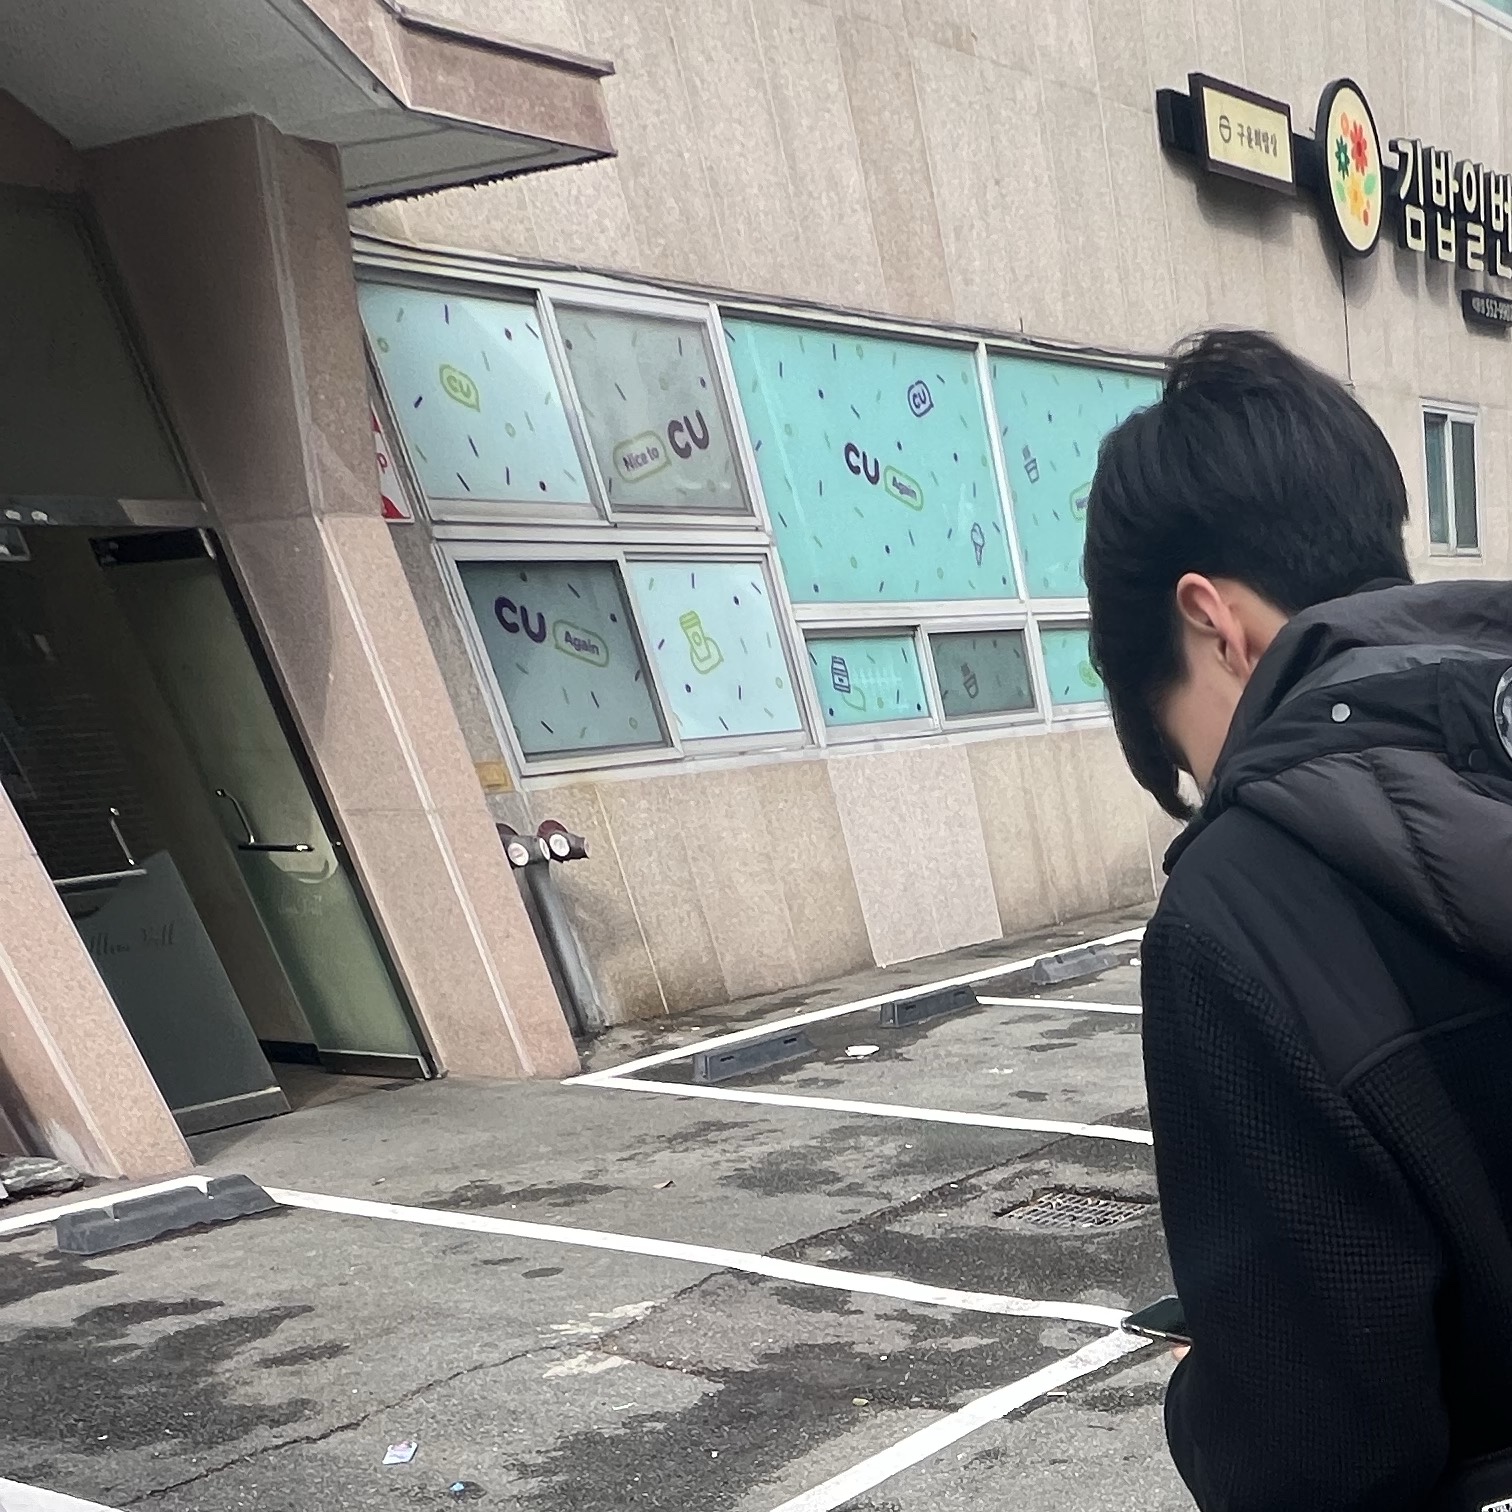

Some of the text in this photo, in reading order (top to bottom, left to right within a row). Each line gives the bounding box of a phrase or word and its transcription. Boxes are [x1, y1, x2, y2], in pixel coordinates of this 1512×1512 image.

[446, 374, 474, 400] CU
[911, 387, 928, 410] CU
[622, 452, 649, 472] Nice
[667, 409, 710, 459] CU
[844, 442, 880, 486] CU
[494, 596, 600, 657] CU Again
